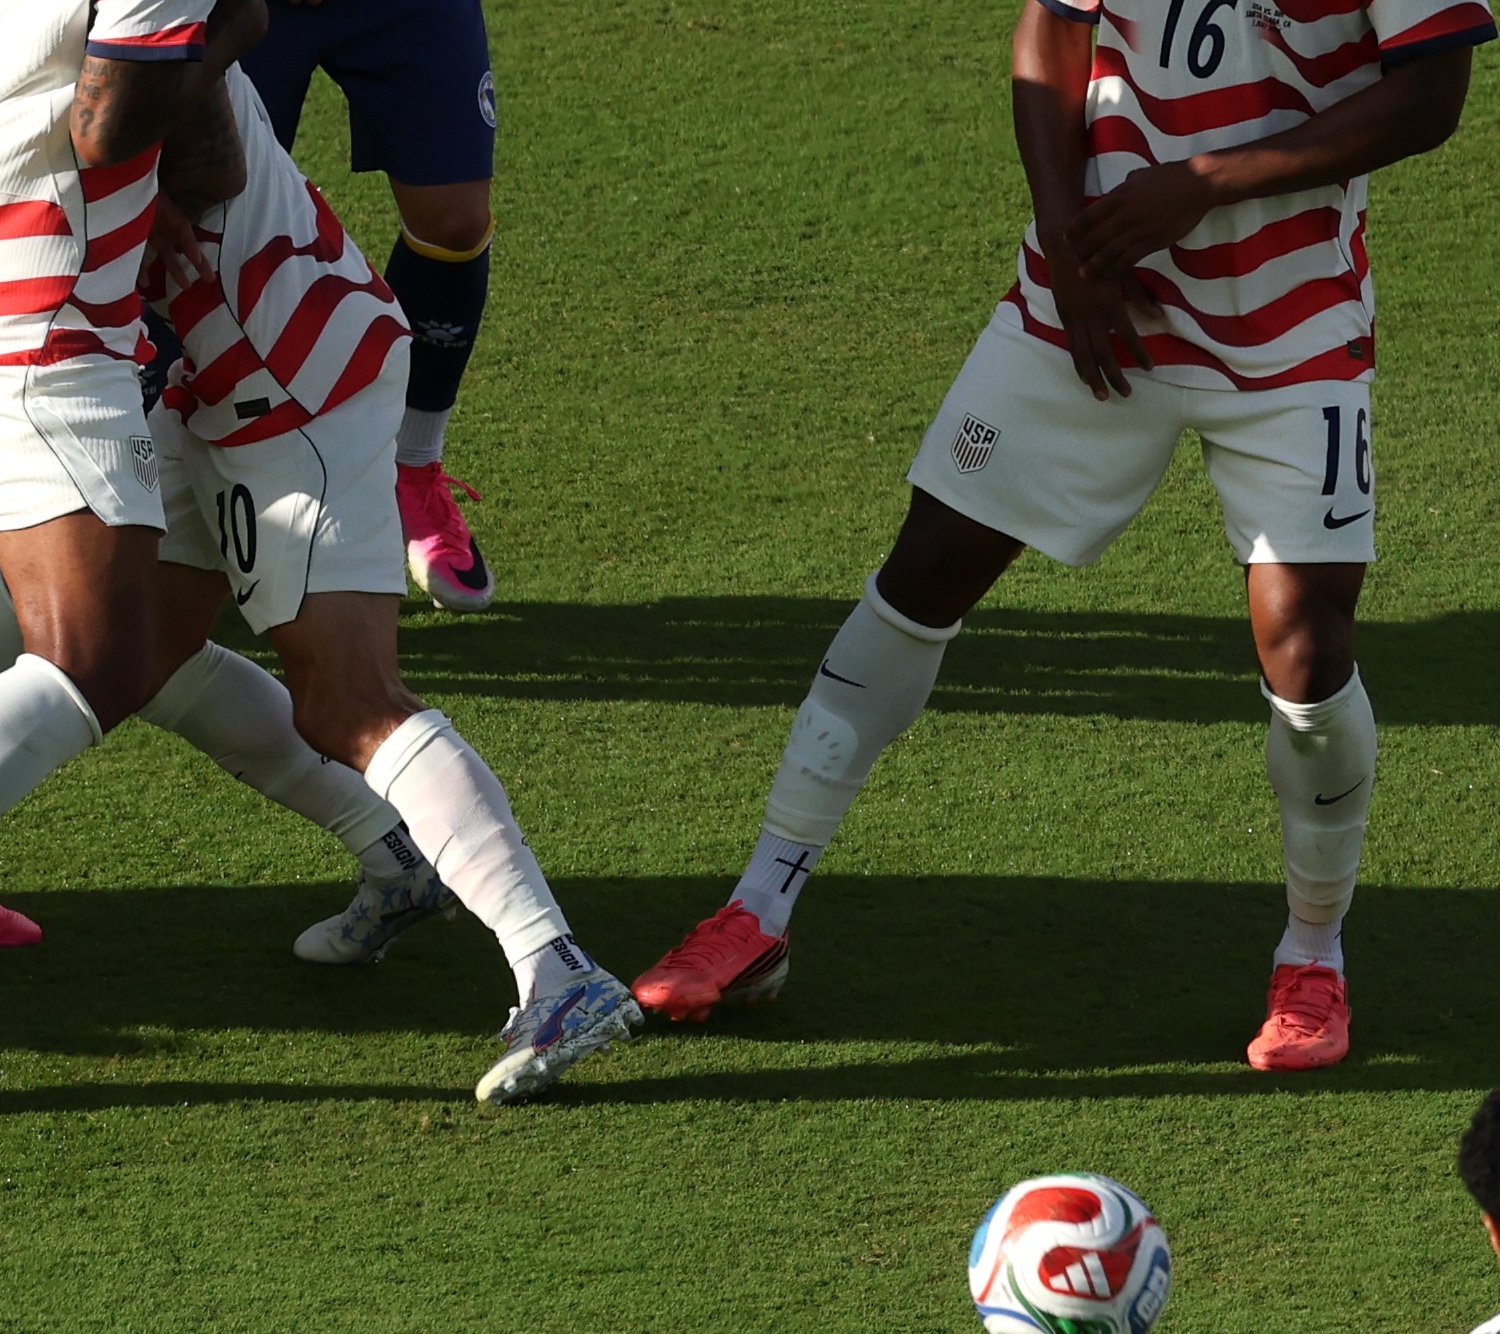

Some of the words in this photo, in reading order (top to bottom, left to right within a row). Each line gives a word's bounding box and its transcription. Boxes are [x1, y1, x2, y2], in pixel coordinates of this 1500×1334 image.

[133, 439, 153, 460] USA
[963, 417, 996, 445] USA
[1321, 406, 1371, 496] 16
[216, 484, 257, 573] 10
[382, 831, 415, 871] ESIGN
[550, 937, 583, 972] ESIGN
